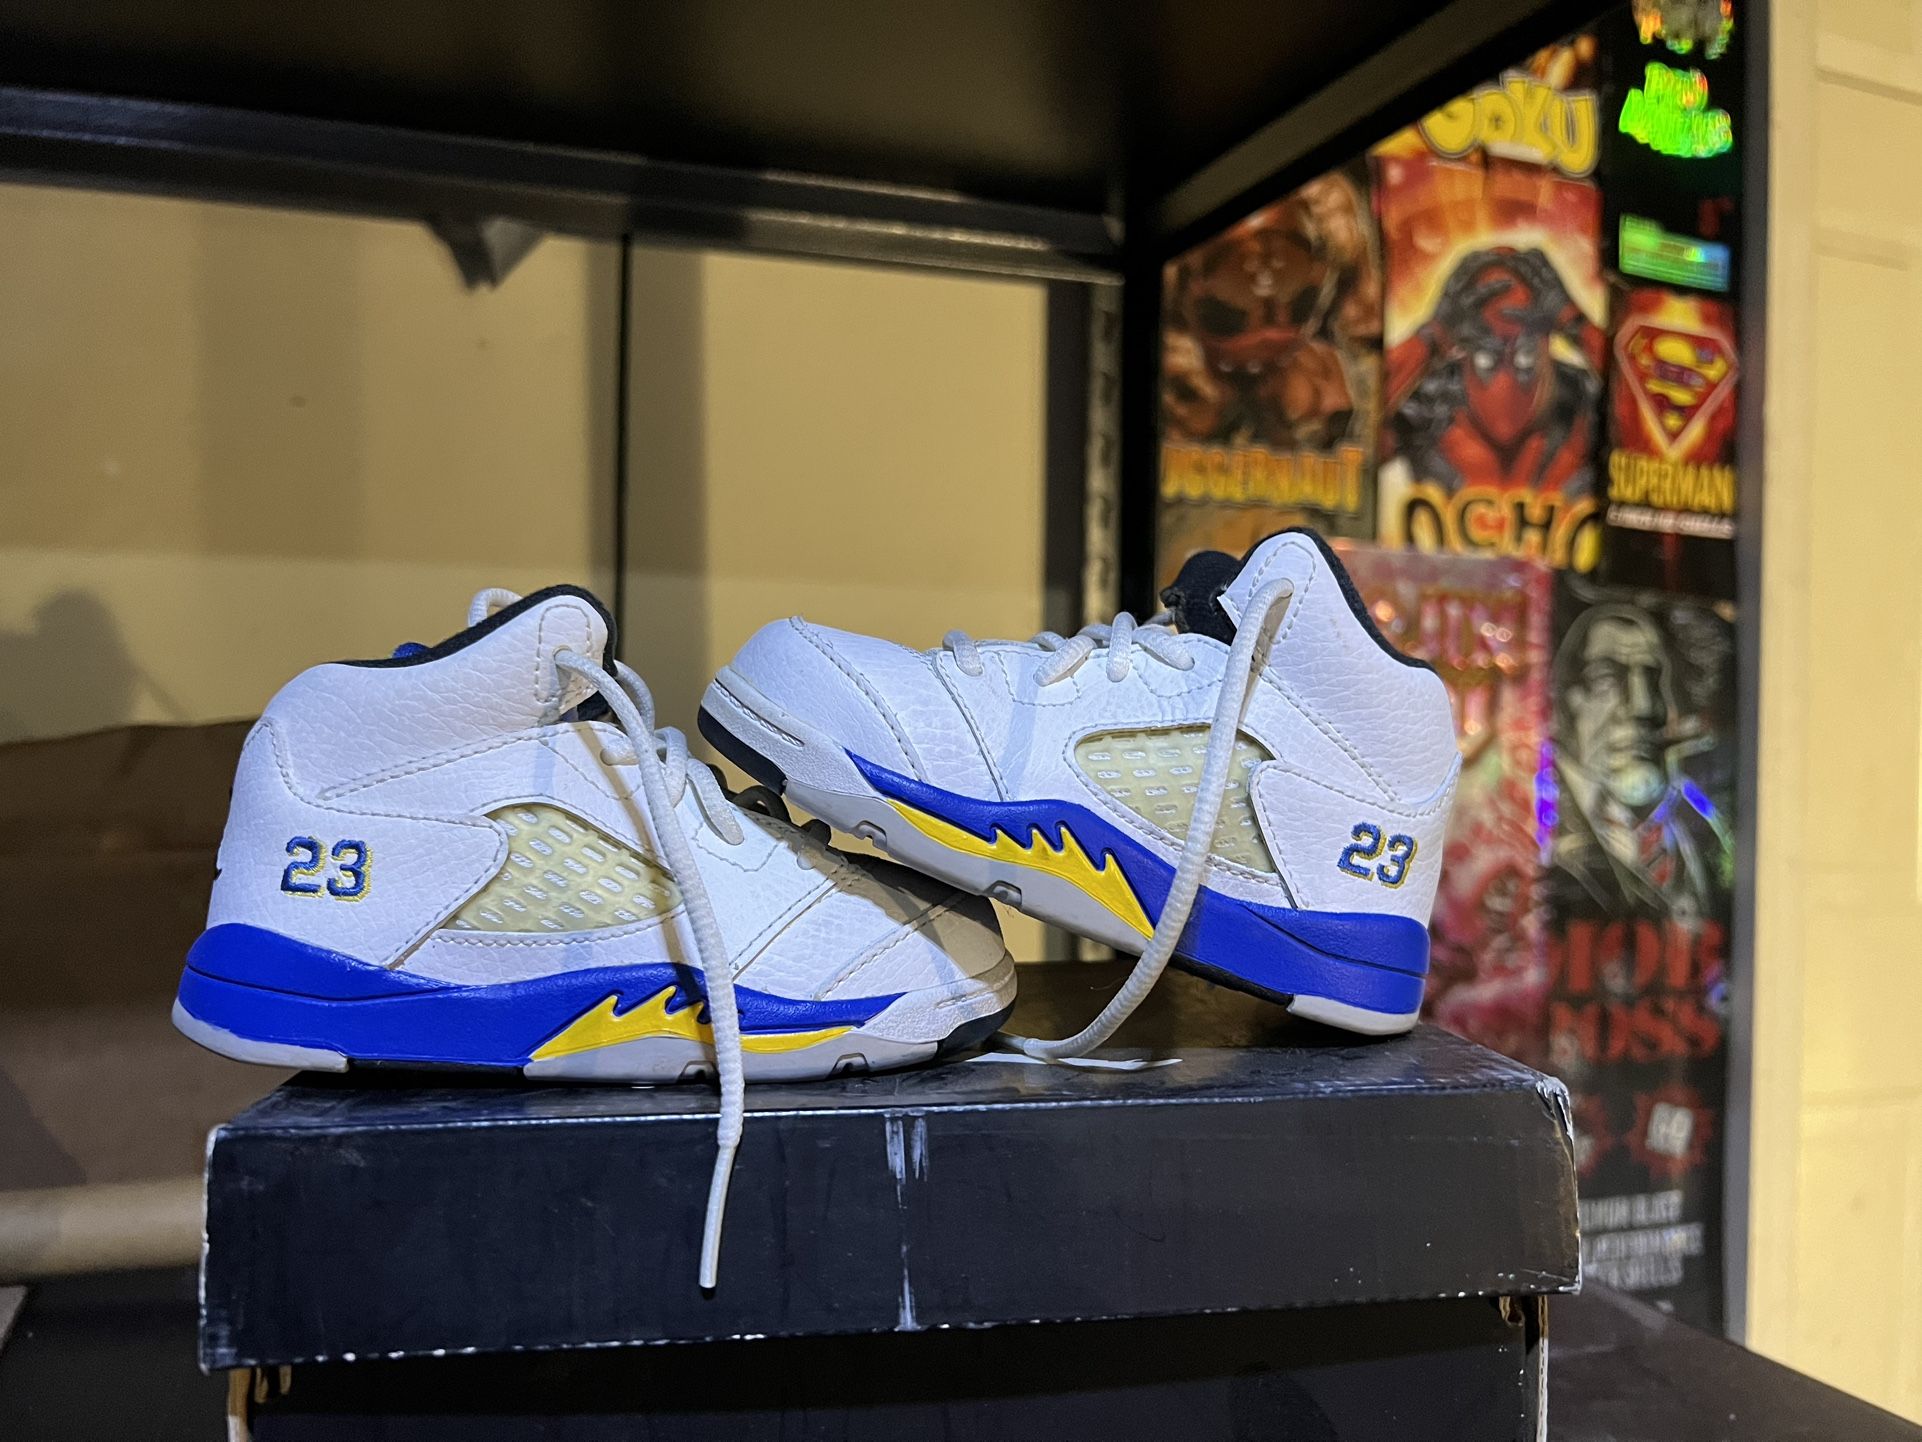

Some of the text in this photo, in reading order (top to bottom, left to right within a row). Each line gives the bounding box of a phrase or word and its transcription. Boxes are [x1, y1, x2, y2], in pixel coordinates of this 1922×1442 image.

[1160, 446, 1364, 514] UGGERNAUT
[1608, 449, 1735, 516] SUPERMAN
[281, 836, 373, 902] 23
[1337, 822, 1418, 889] 23
